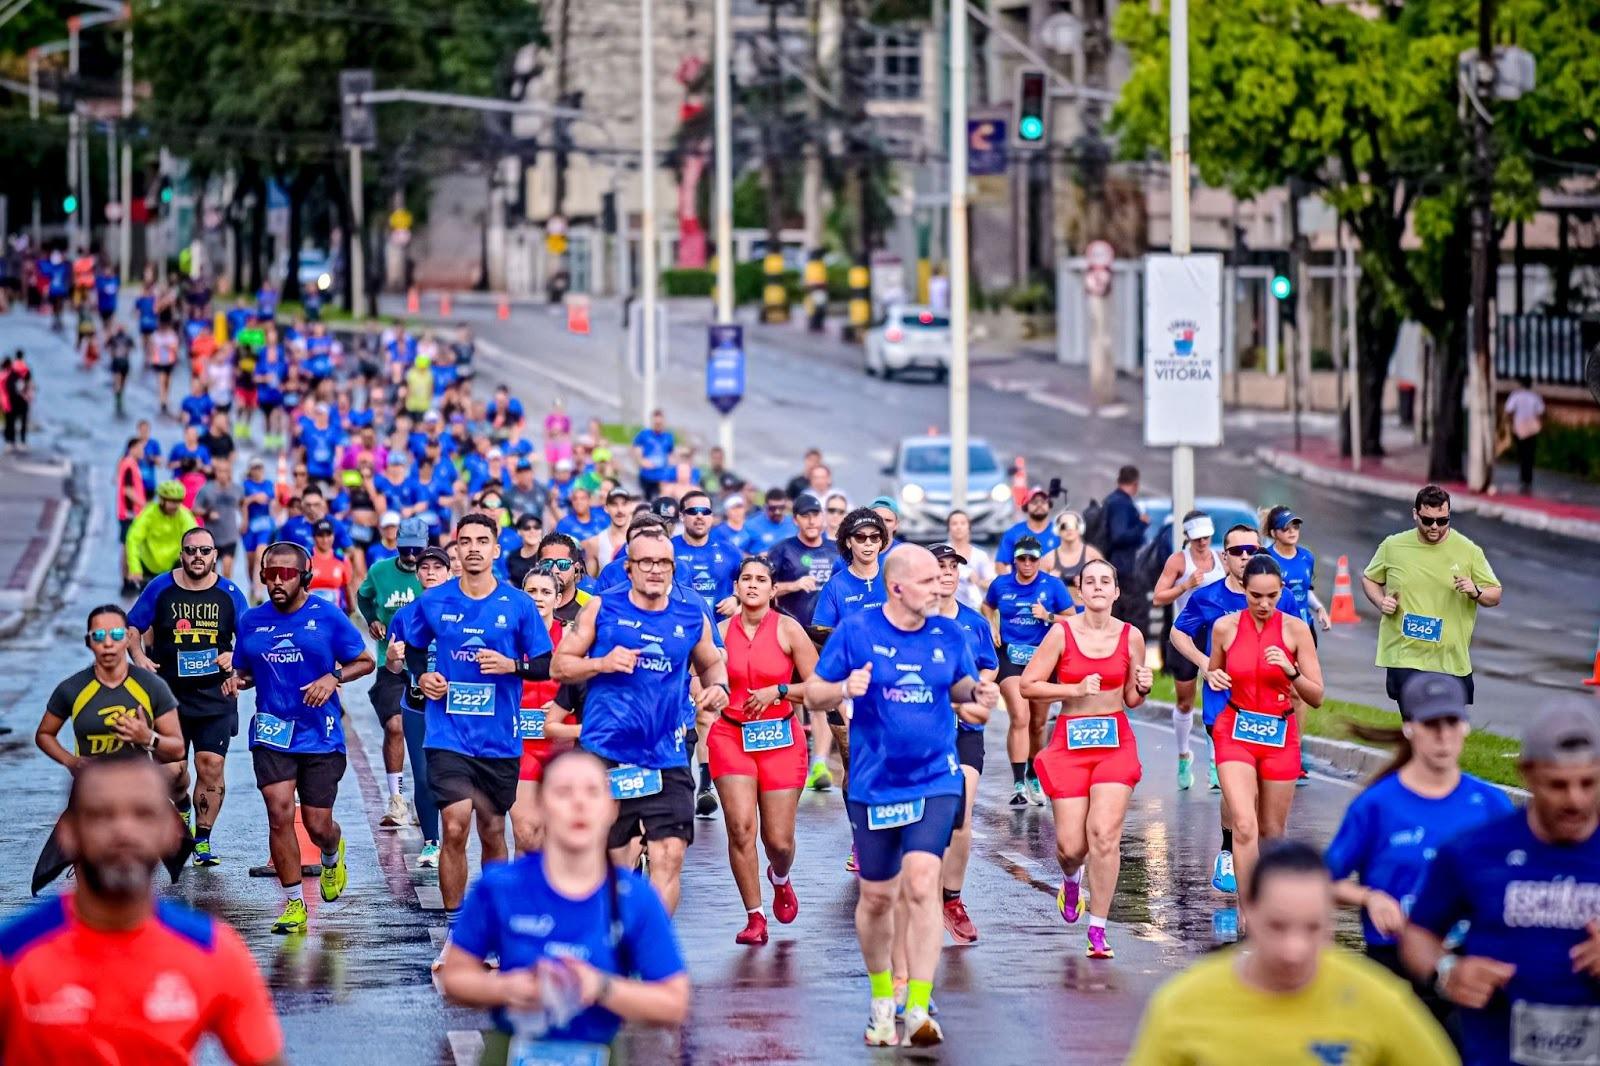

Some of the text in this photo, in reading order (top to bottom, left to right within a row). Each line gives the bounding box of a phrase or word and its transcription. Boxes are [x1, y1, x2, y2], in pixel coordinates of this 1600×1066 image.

[1201, 359, 1212, 367] DE
[1407, 622, 1433, 635] 1246
[184, 659, 210, 670] 1384
[453, 694, 491, 706] 2227
[1073, 728, 1109, 741] 2727
[1238, 720, 1278, 737] 3429
[747, 730, 784, 743] 3426
[617, 776, 645, 791] 138
